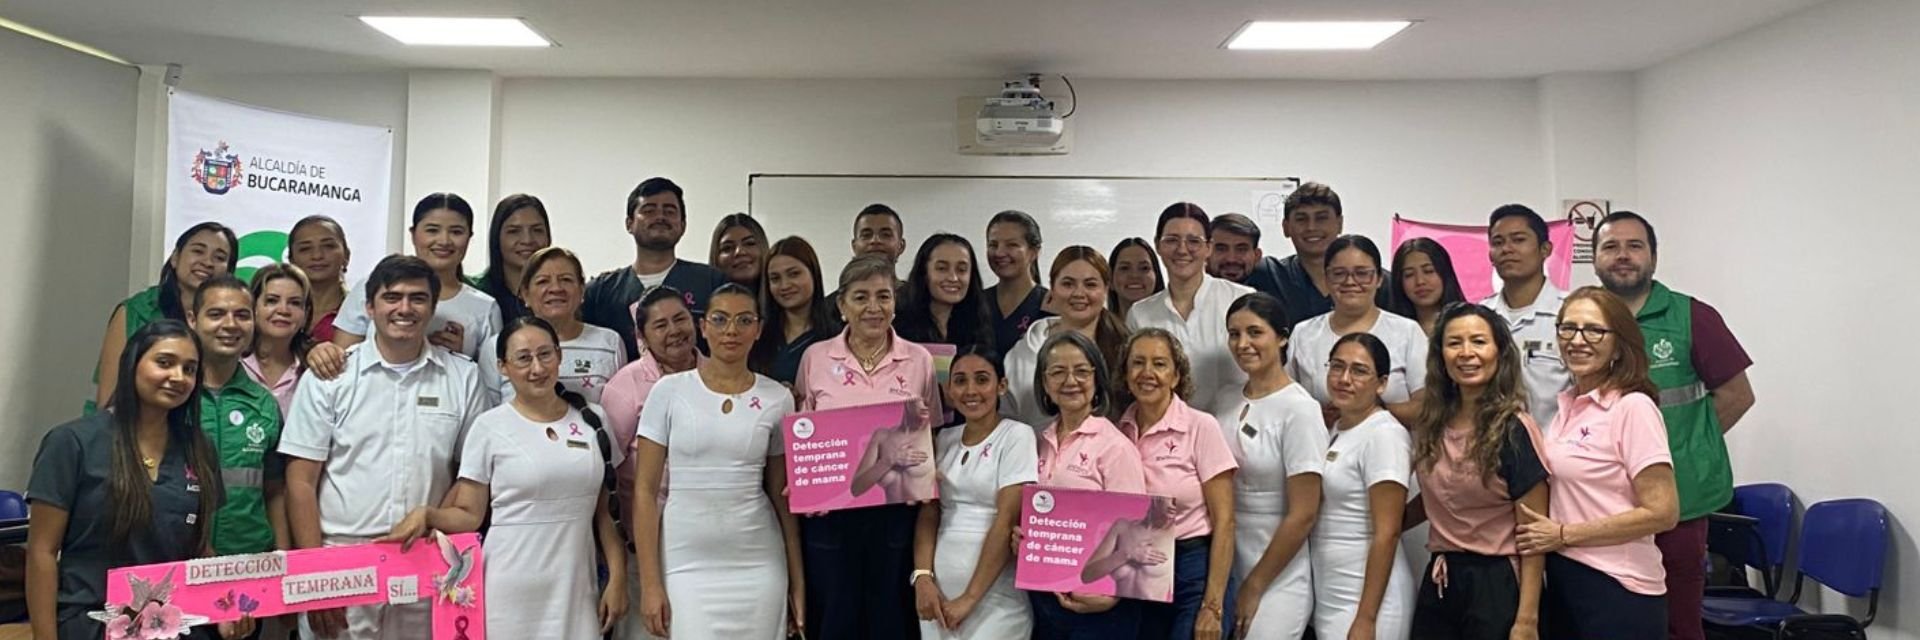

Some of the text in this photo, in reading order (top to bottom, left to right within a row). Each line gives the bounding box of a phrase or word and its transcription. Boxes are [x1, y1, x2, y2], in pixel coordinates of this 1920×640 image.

[250, 156, 326, 179] ALCALDÍA DE
[247, 174, 362, 202] BUCARAMANGA
[792, 439, 848, 451] Detección
[793, 451, 846, 463] temprana
[794, 462, 849, 475] de cáncer
[795, 475, 846, 486] de mama
[1029, 515, 1087, 529] Detección
[1028, 529, 1083, 542] temprana
[1026, 541, 1085, 554] de cáncer
[1025, 553, 1078, 567] de mama
[189, 556, 283, 580] DETECCIÓN
[285, 573, 375, 596] TEMPRANA
